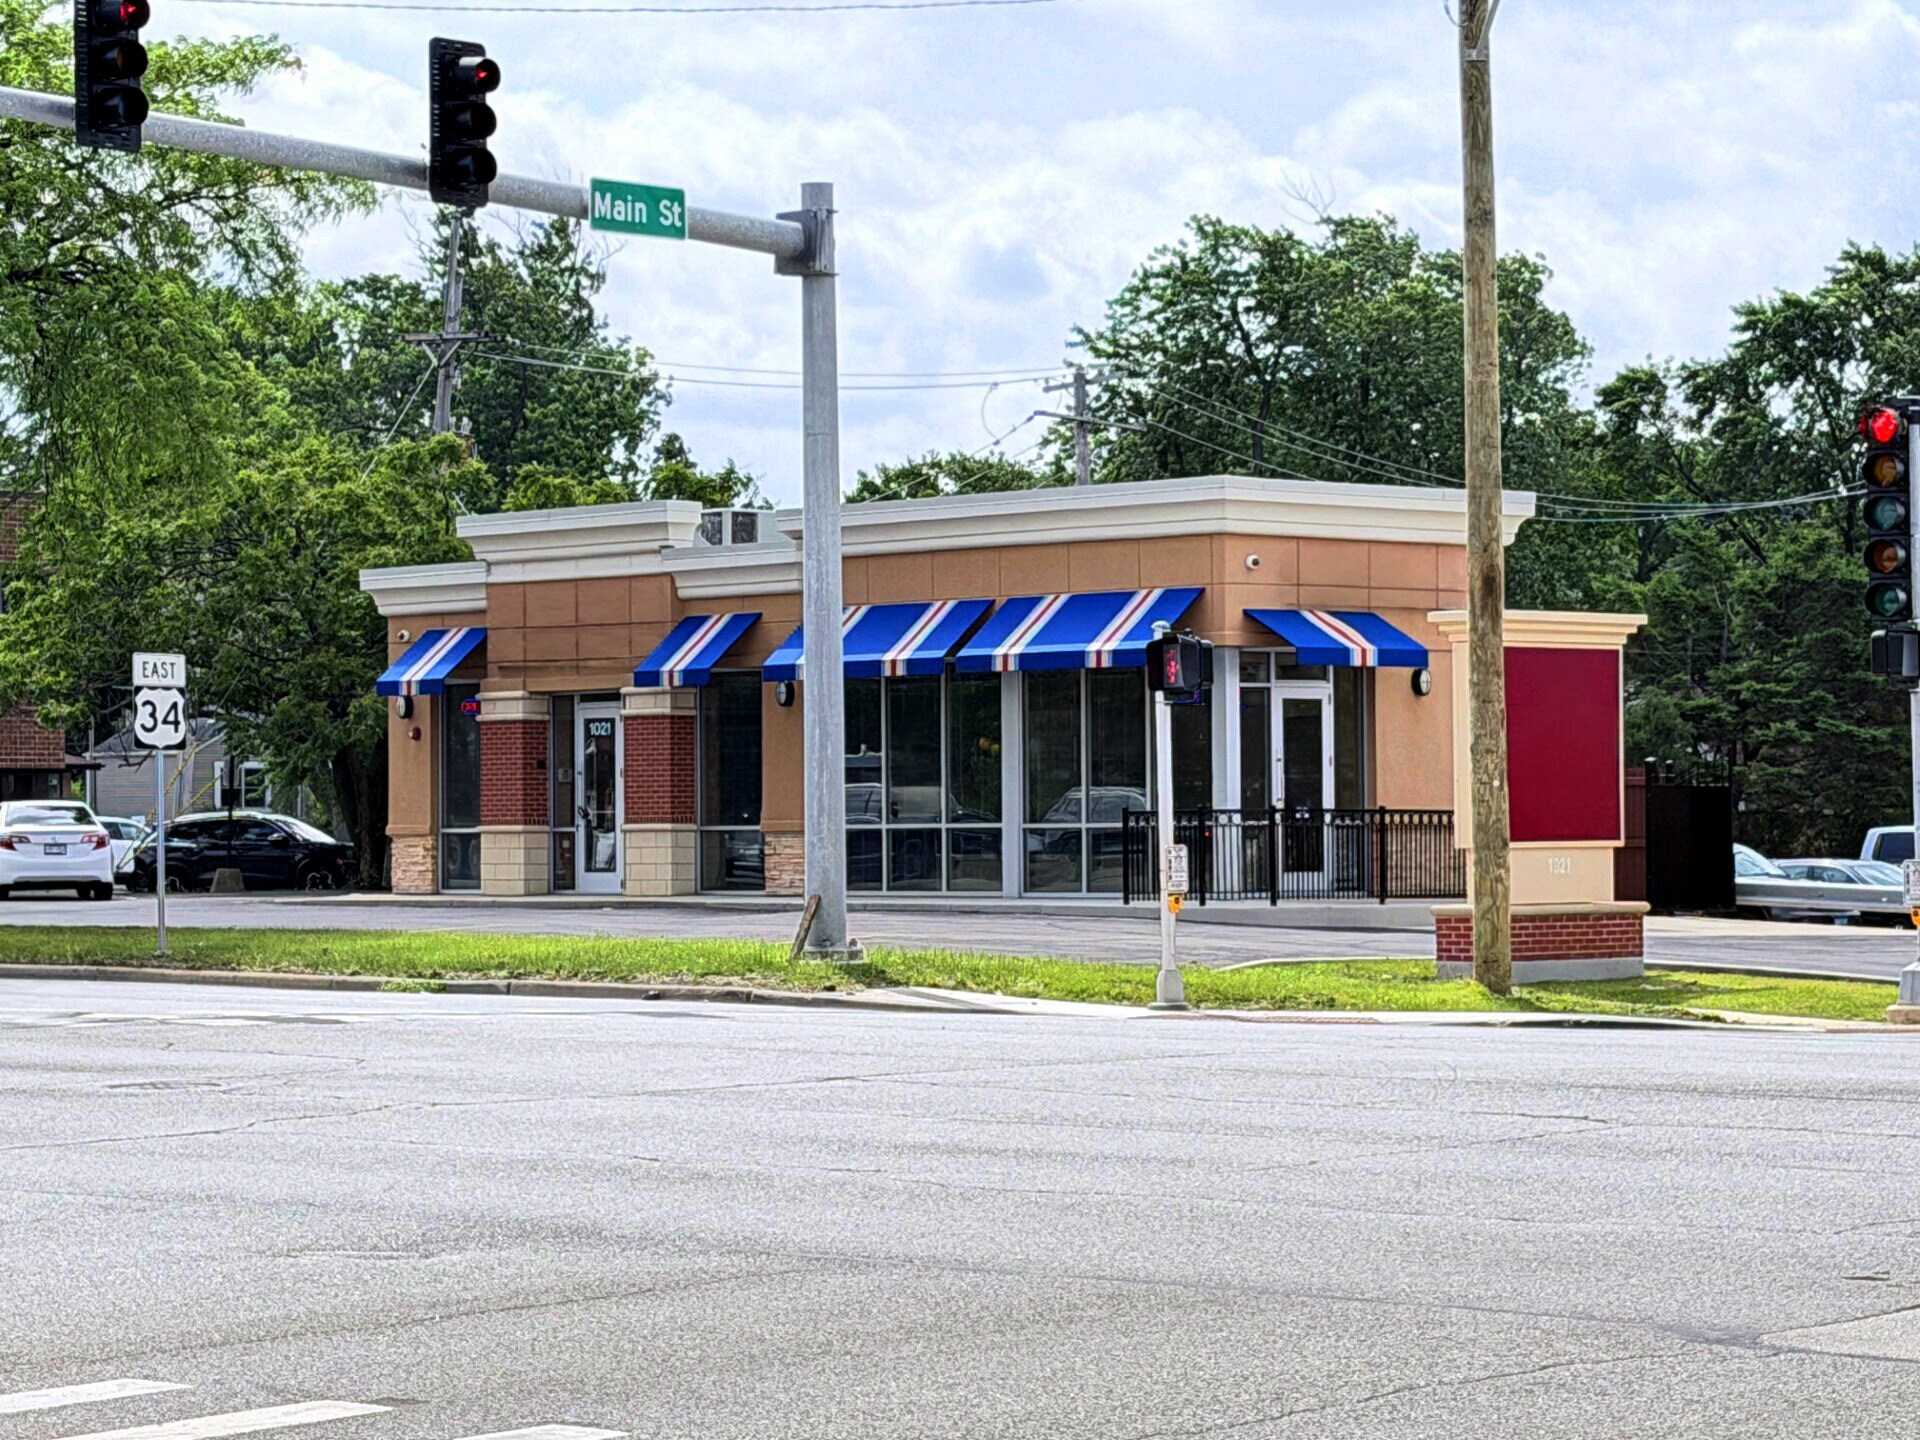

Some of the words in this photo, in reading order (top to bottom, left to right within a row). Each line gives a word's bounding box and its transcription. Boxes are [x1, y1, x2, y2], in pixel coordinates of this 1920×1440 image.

[594, 190, 647, 224] Main
[658, 198, 682, 228] St
[142, 661, 176, 679] EAST
[140, 699, 181, 733] 34
[589, 721, 611, 736] 1021
[1547, 856, 1571, 874] 1021
